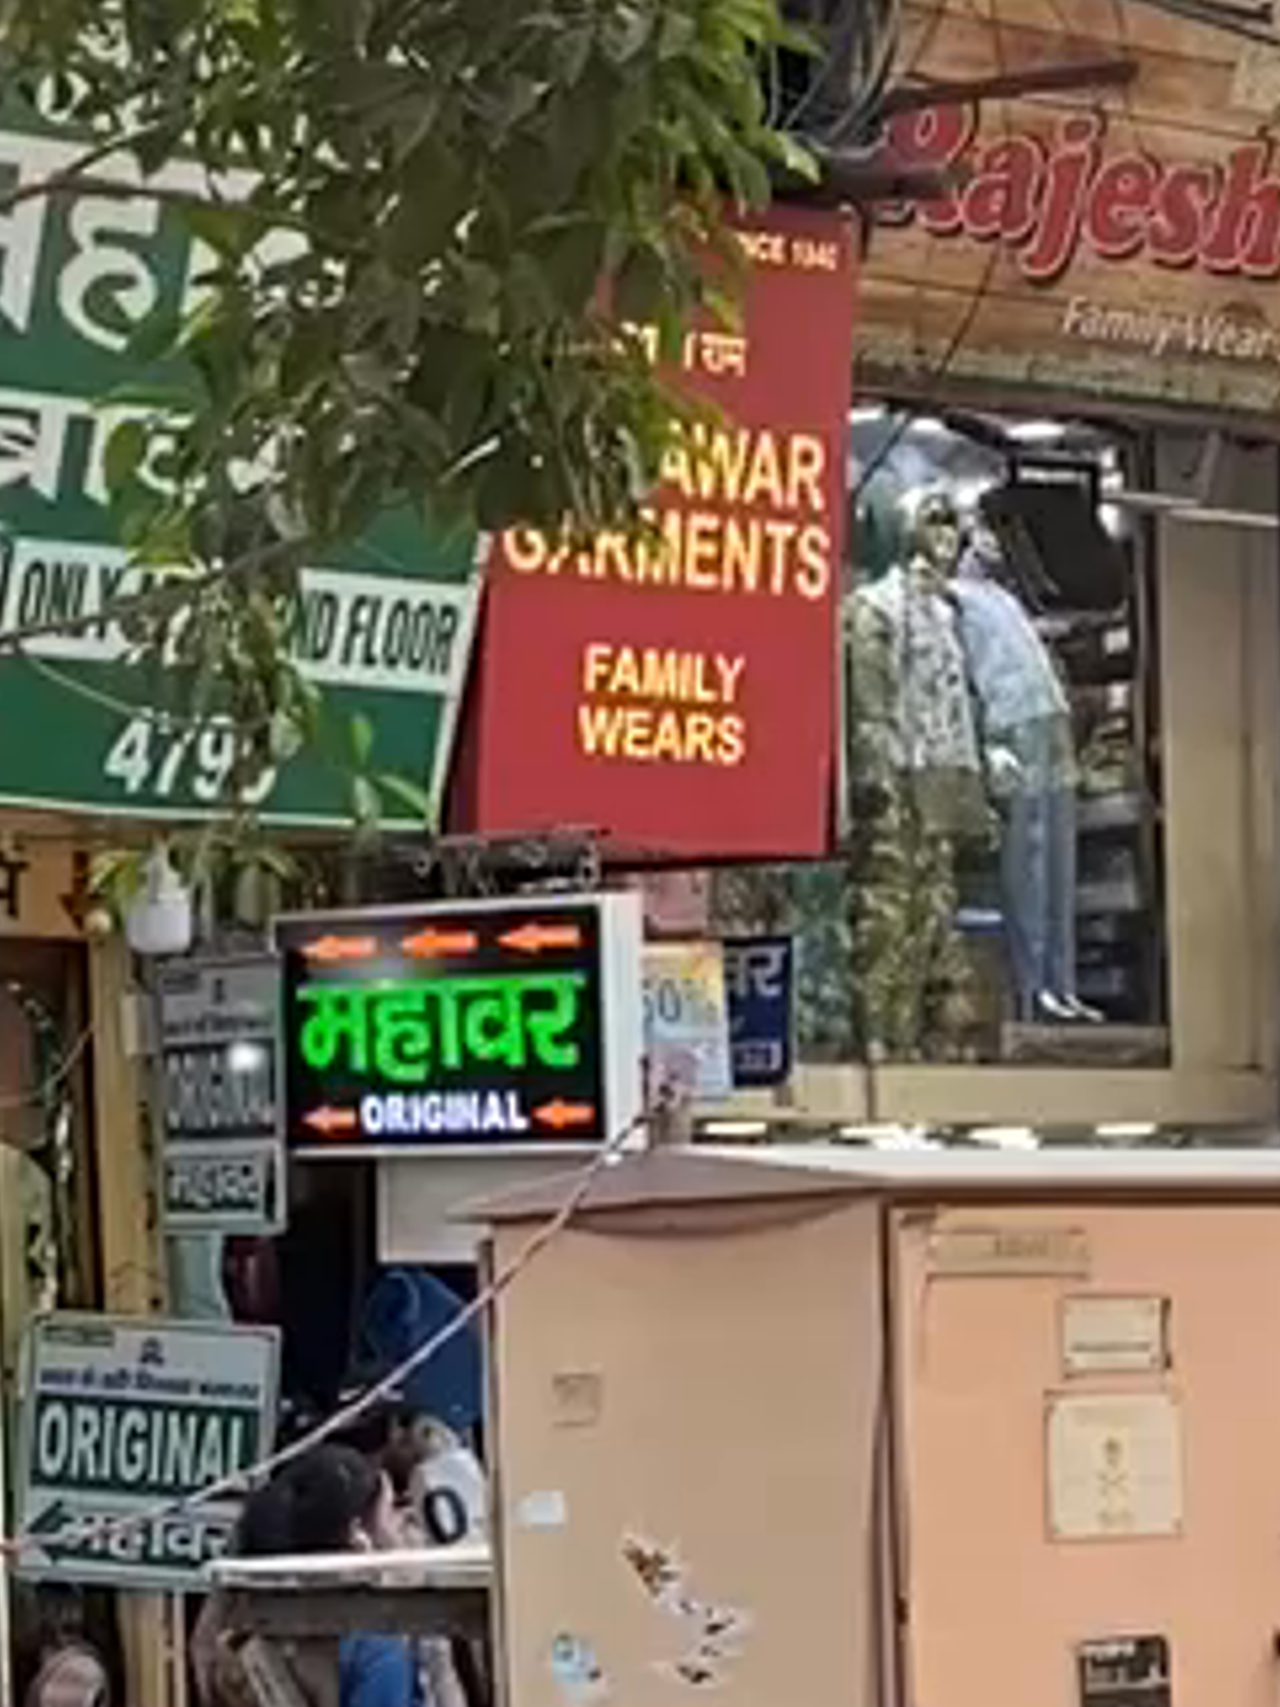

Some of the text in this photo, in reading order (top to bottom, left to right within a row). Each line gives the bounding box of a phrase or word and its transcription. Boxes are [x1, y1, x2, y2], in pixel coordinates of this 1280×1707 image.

[1063, 293, 1169, 358] Family
[1184, 314, 1270, 361] Wear
[658, 418, 826, 513] AWAR
[339, 589, 458, 677] FLOOR
[583, 640, 746, 706] FAMILY
[577, 704, 746, 766] WEARS
[295, 972, 585, 1083] महावर
[360, 1090, 529, 1136] ORIGINAL
[39, 1401, 244, 1487] ORIGINAL
